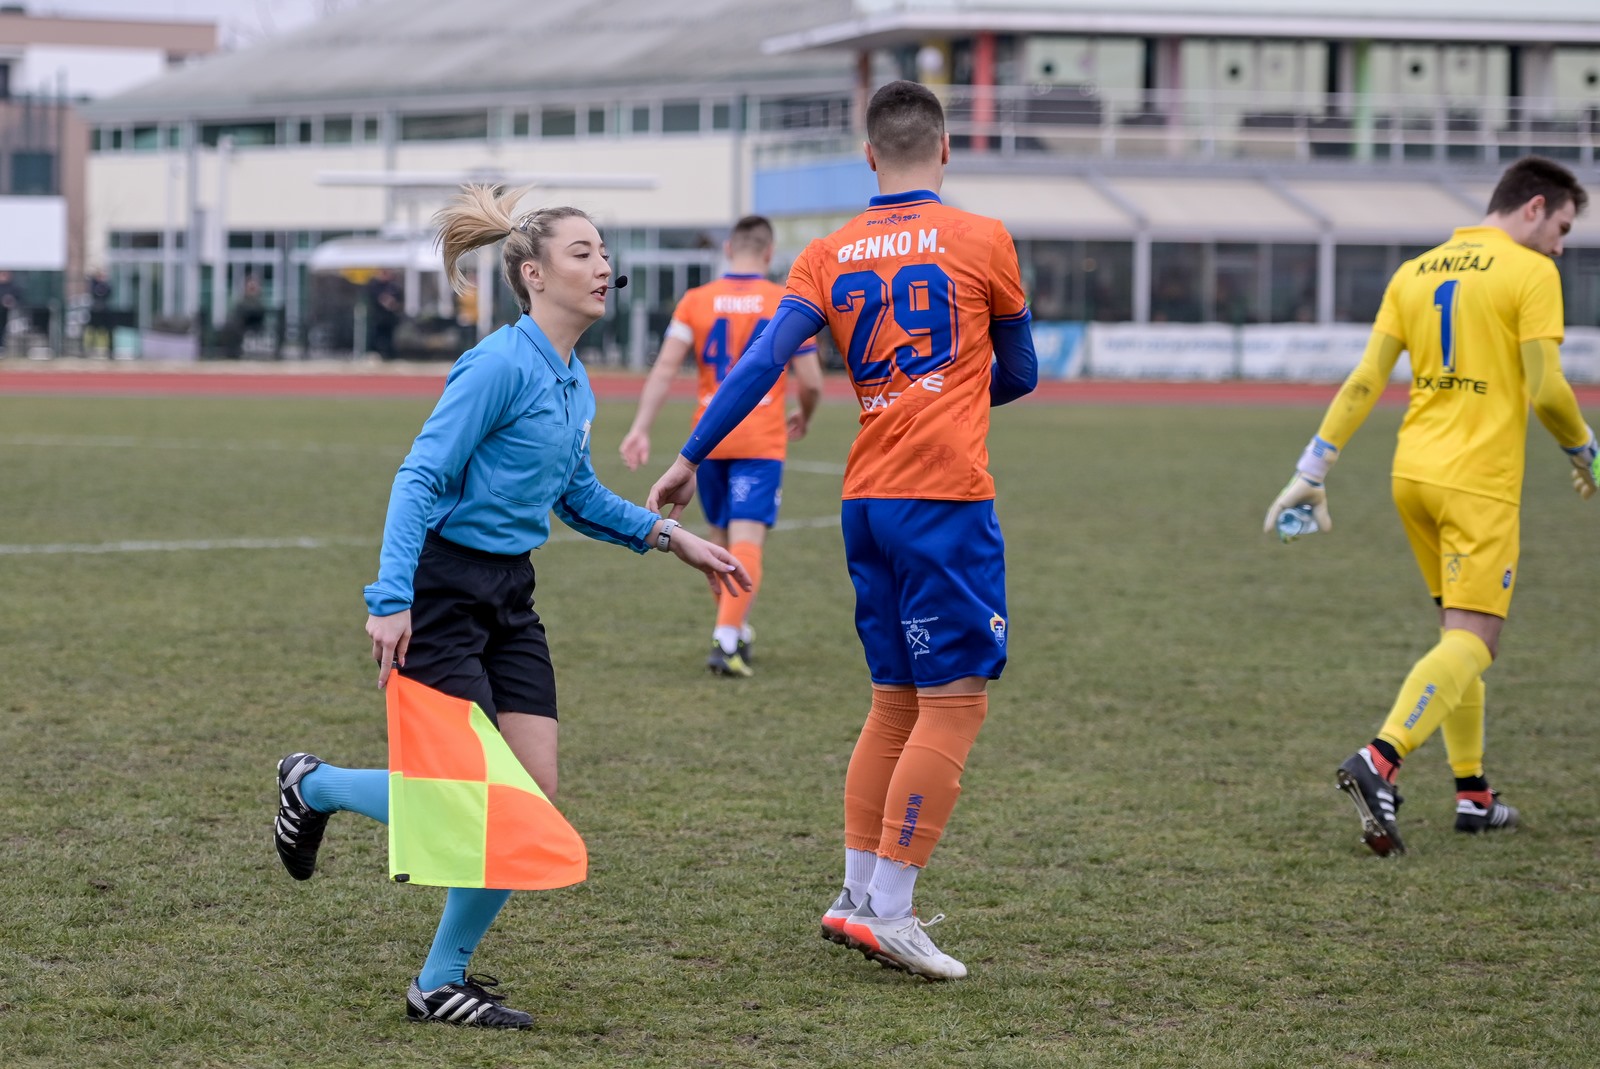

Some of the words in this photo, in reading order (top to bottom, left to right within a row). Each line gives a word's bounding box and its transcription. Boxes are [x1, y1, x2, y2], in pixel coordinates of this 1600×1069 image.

[837, 231, 912, 264] BENKO
[917, 228, 946, 254] M.
[1415, 250, 1495, 277] KANIŽAJ
[831, 263, 959, 387] 29
[1433, 279, 1460, 374] 1
[908, 793, 924, 807] NK
[898, 807, 920, 847] VARTEKS
